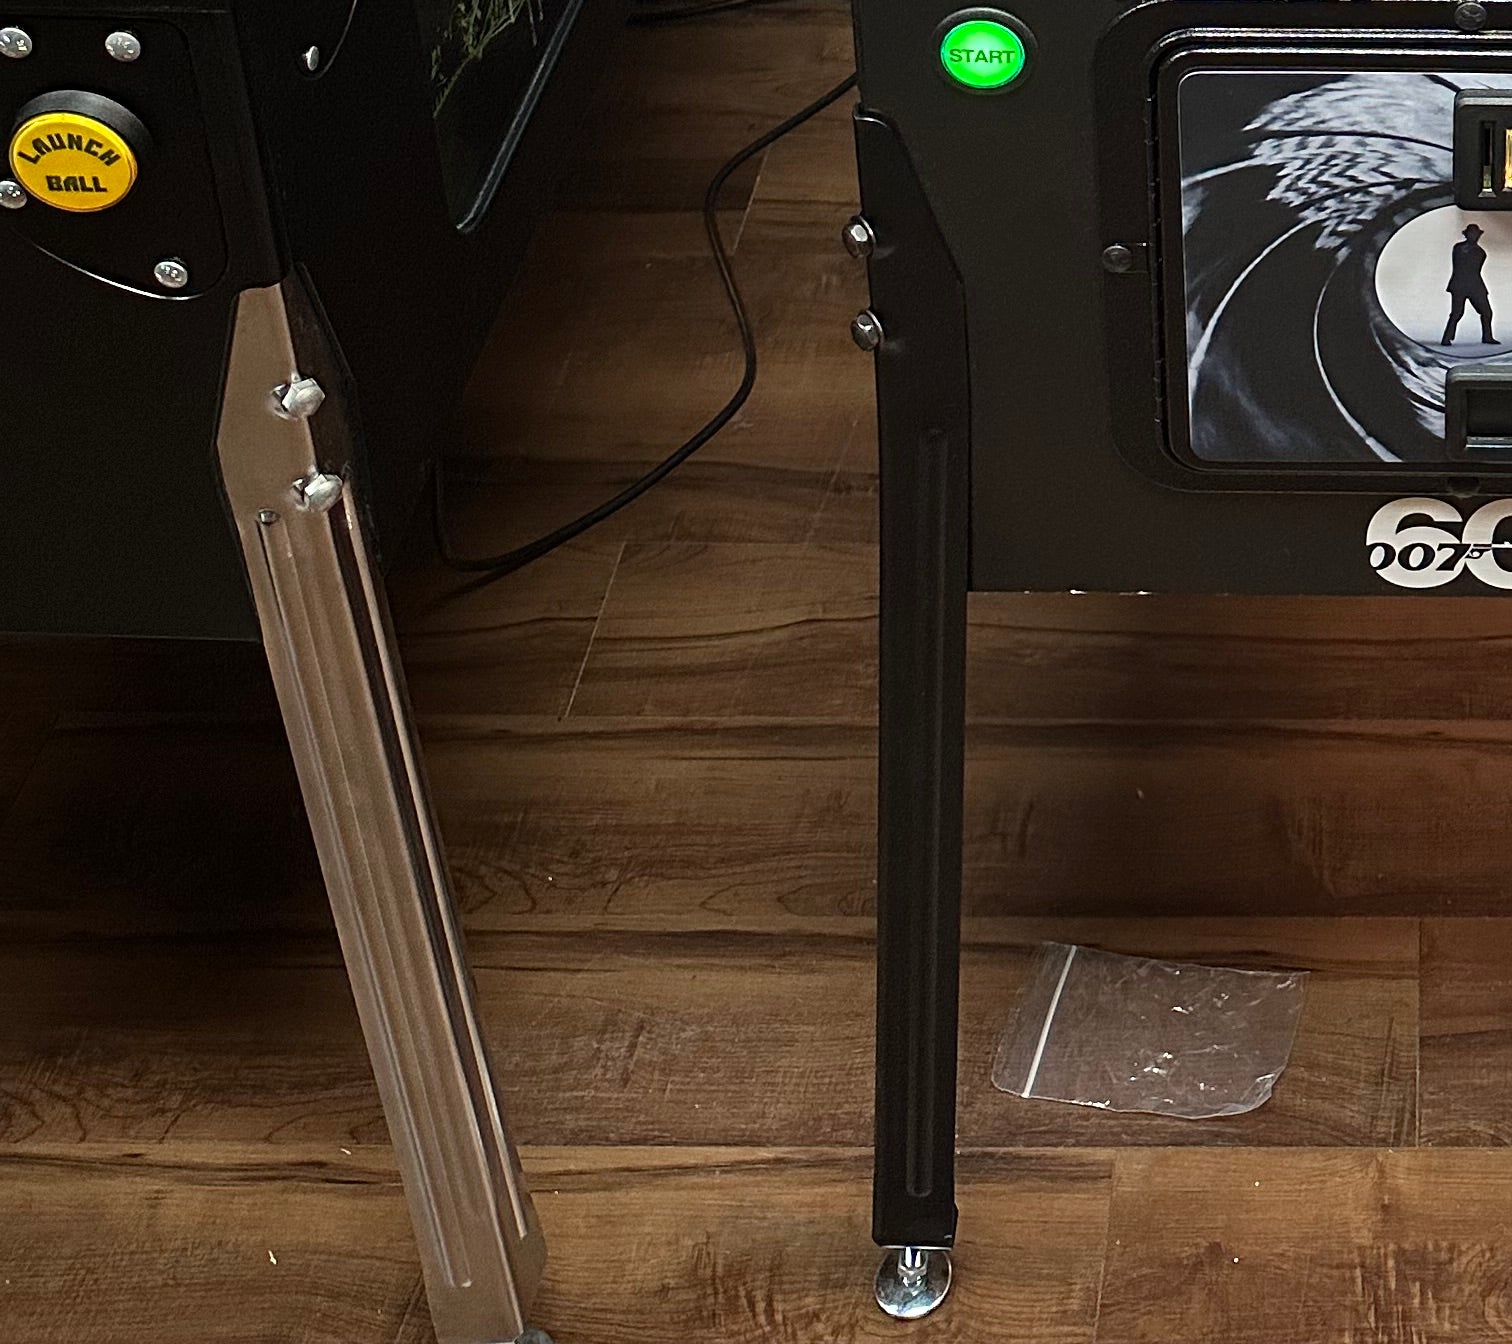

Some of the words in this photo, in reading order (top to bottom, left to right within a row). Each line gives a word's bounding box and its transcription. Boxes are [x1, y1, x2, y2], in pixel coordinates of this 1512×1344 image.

[949, 49, 1015, 63] START
[18, 132, 123, 167] LAUNCH
[46, 175, 108, 193] BALL
[1367, 542, 1492, 571] 007
